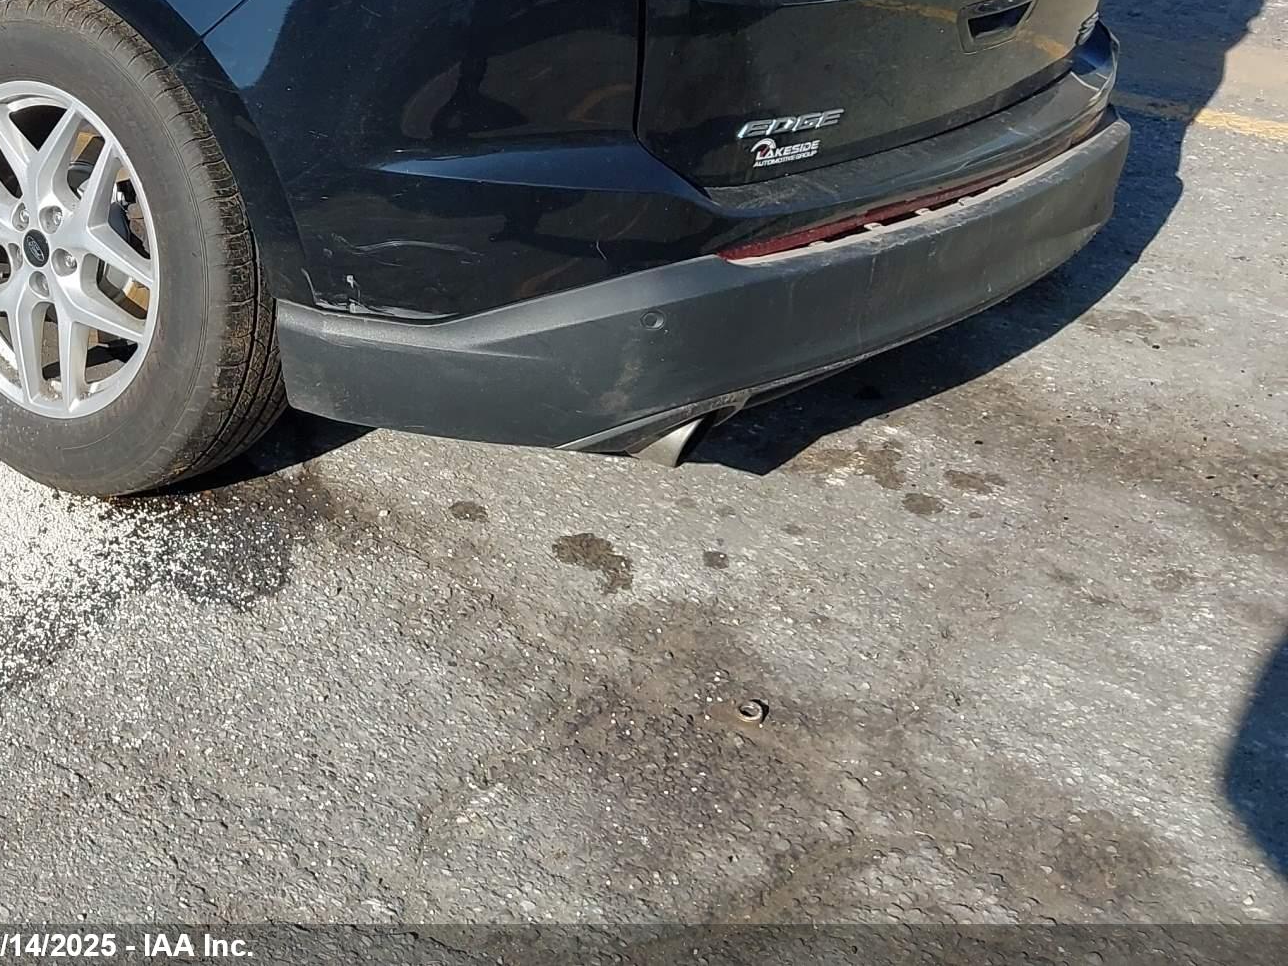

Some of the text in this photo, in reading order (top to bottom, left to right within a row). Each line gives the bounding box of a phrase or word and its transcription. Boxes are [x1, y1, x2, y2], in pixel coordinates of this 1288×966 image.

[737, 108, 845, 139] EDGE
[752, 149, 818, 168] AUTOMOTIVE GROUP
[755, 139, 821, 161] LAKESIDE
